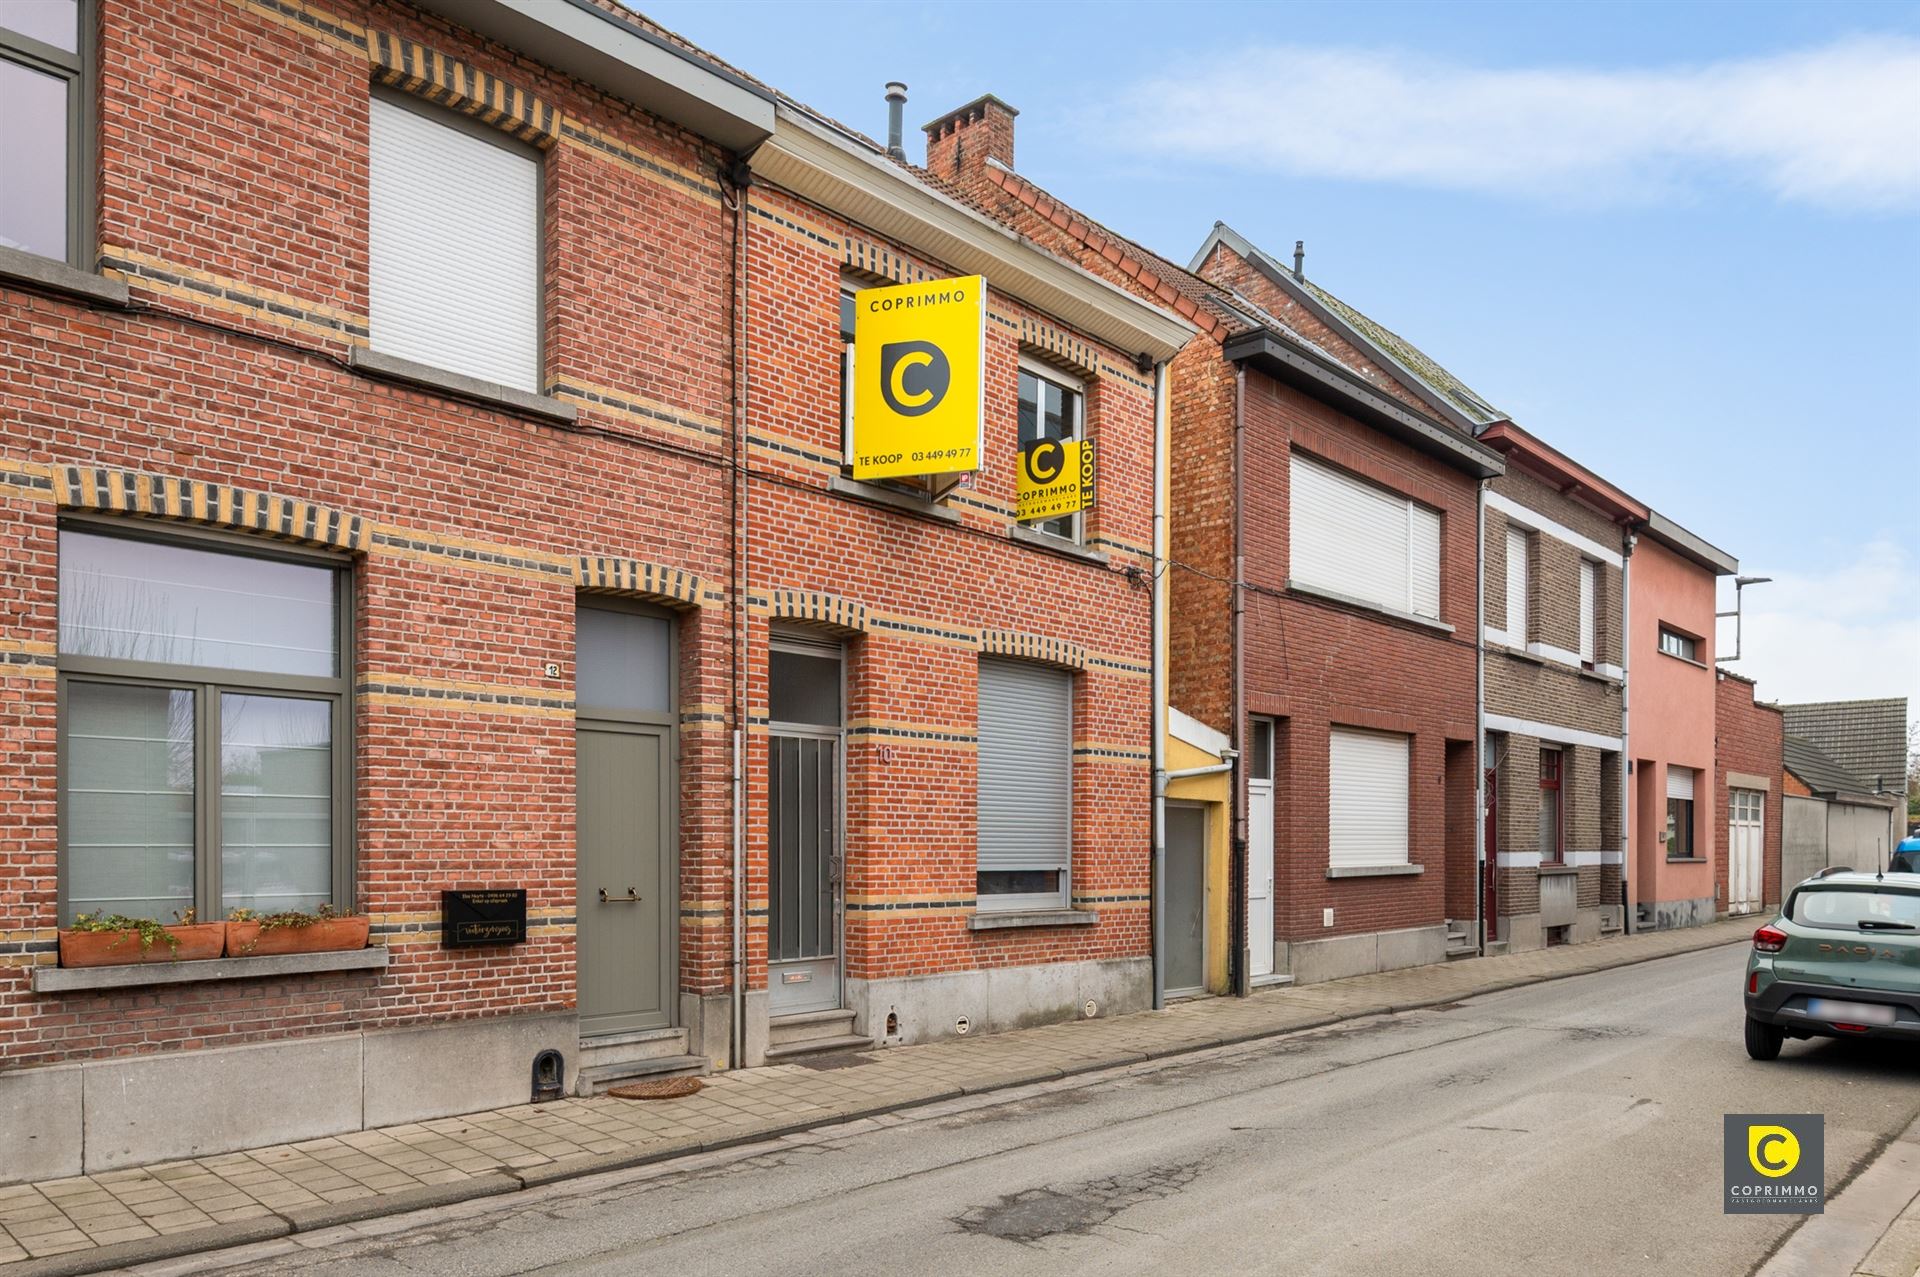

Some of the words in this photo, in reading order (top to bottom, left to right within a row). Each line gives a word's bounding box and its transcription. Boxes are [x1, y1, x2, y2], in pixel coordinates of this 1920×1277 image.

[870, 290, 965, 312] COPRIMMO
[890, 351, 934, 407] C
[860, 456, 870, 466] TE
[873, 453, 903, 465] KOOP
[911, 452, 924, 462] 03
[926, 450, 944, 460] 449
[945, 449, 957, 459] 49
[960, 448, 971, 458] 77
[1031, 443, 1056, 479] C
[1082, 440, 1094, 487] KOOP
[1030, 505, 1047, 514] 449
[1051, 503, 1062, 511] 49
[1066, 500, 1077, 509] 77
[1082, 490, 1094, 509] TE
[549, 666, 557, 675] 12
[878, 745, 892, 763] 10
[1818, 943, 1895, 958] DACIA
